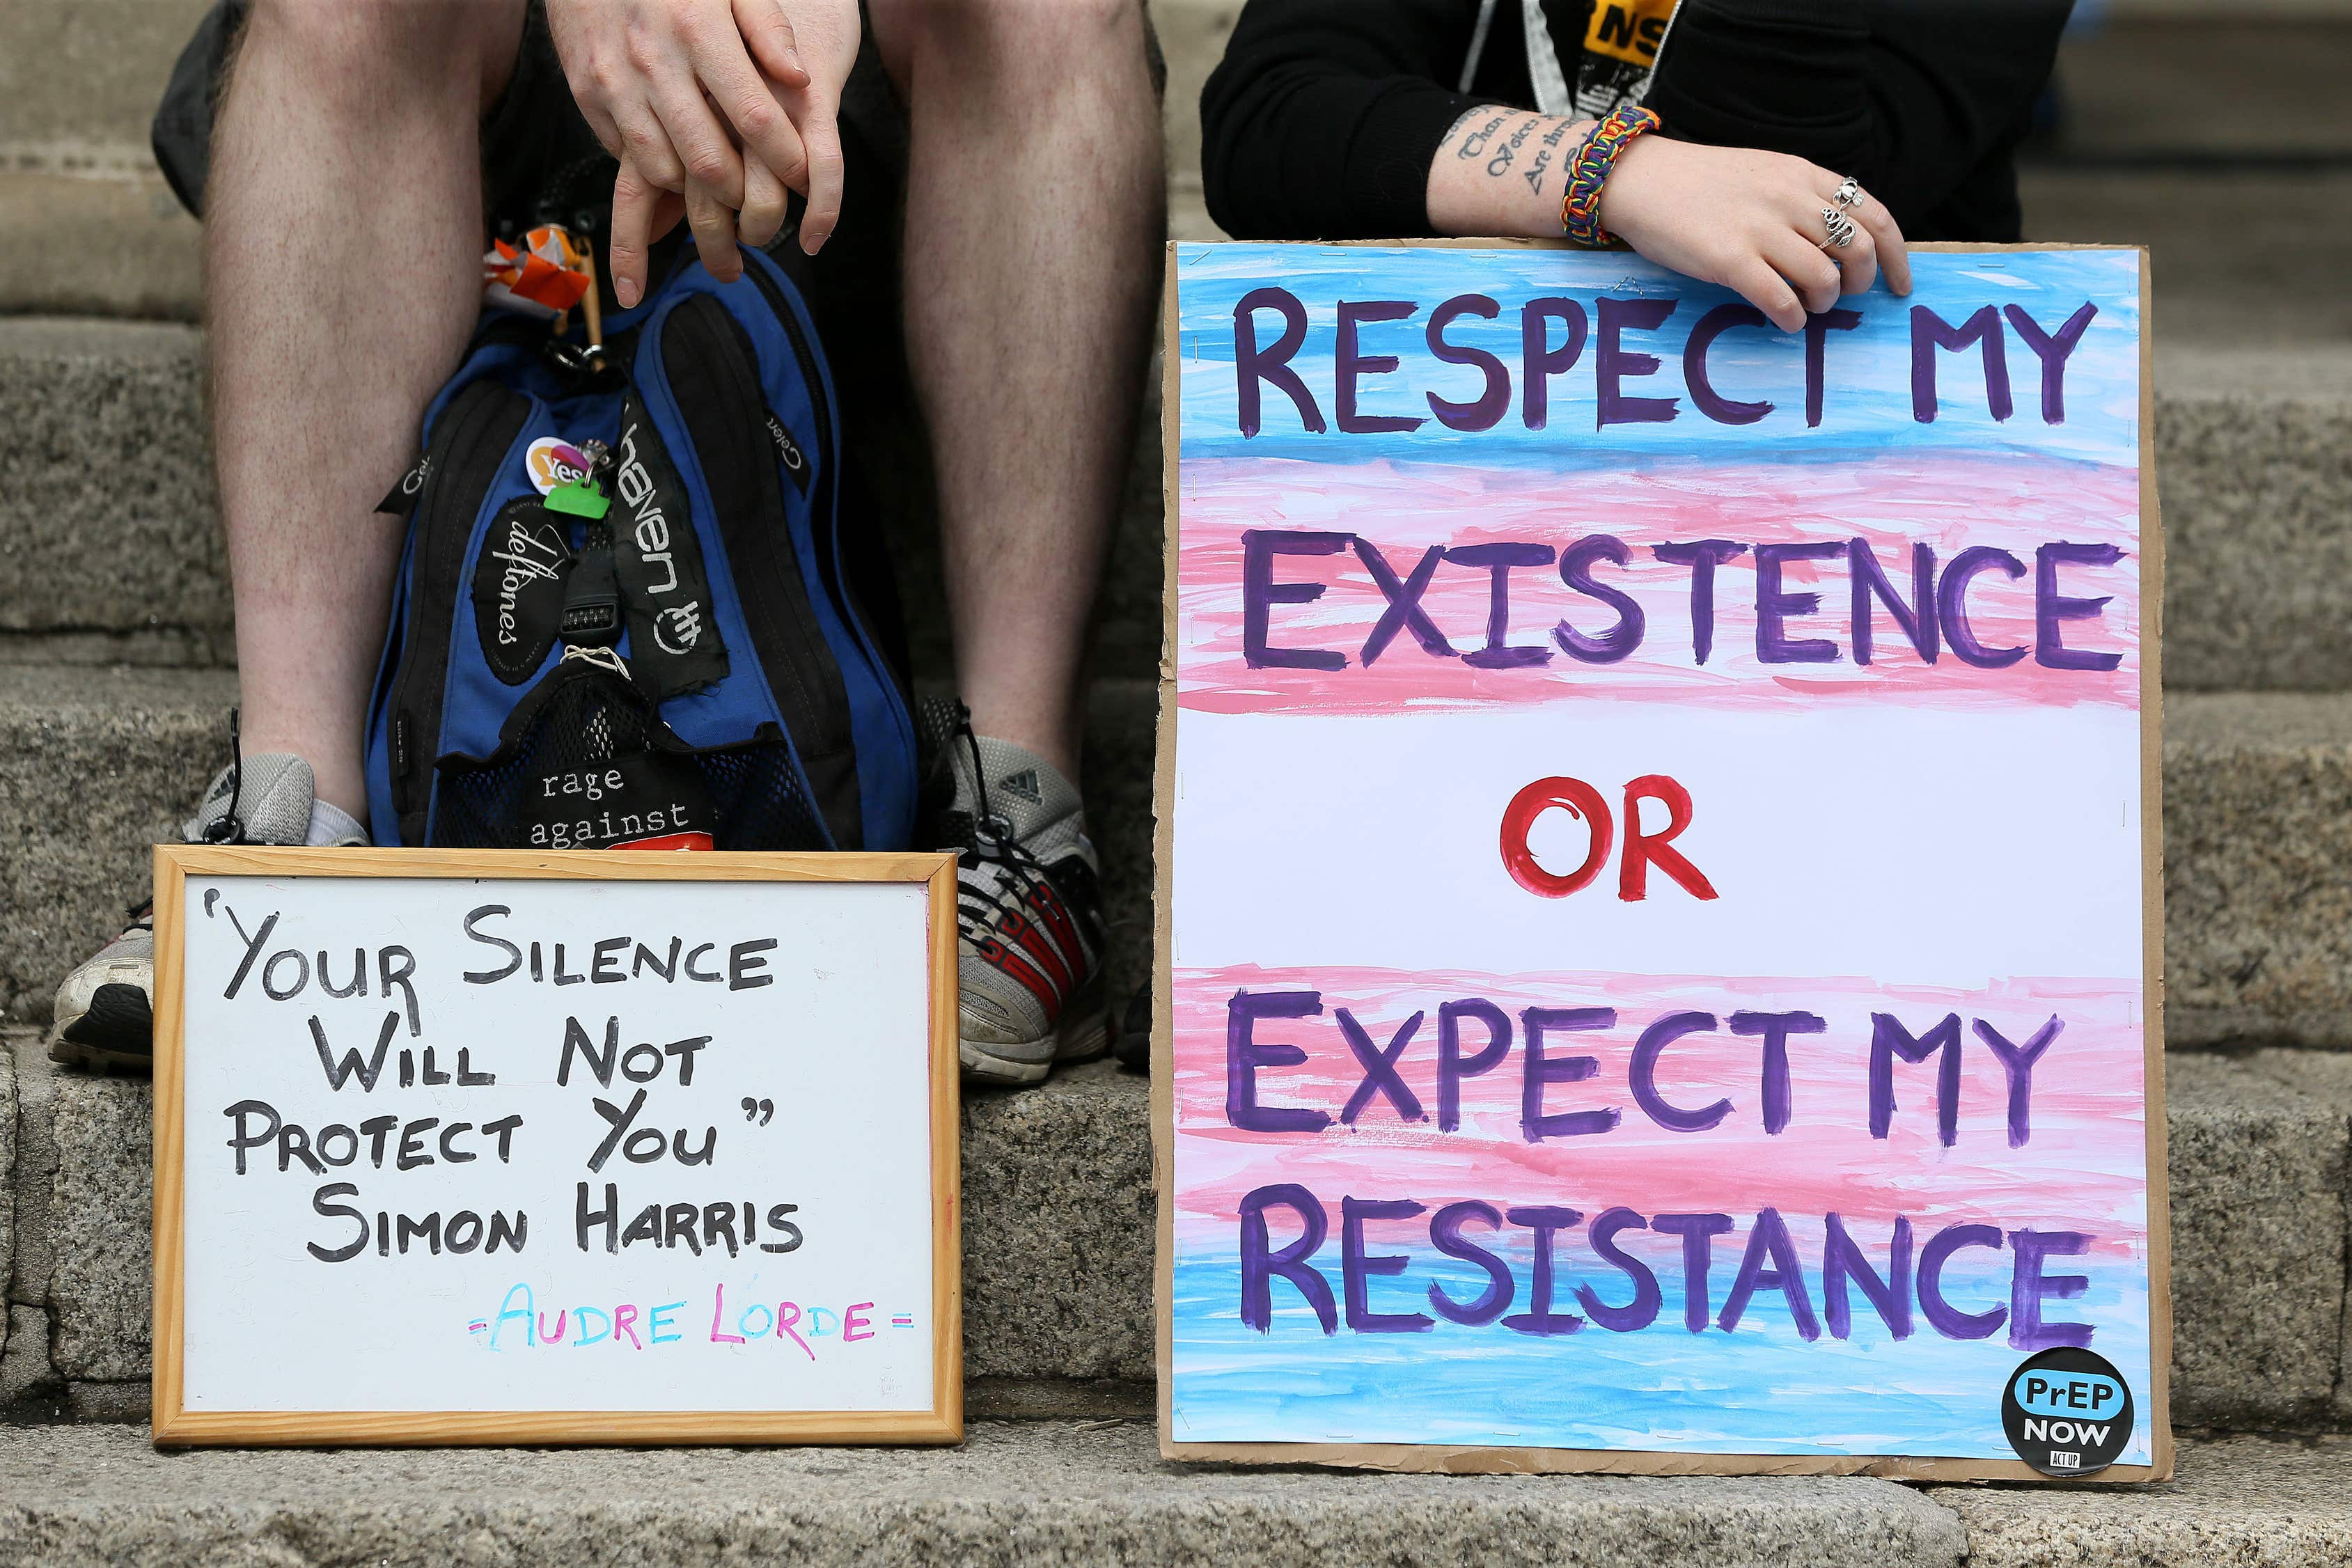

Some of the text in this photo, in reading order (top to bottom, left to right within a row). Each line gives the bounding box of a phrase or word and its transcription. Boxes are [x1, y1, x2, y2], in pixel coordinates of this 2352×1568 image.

[1233, 286, 2098, 439] RESPECT MY
[540, 453, 583, 485] Yes
[492, 521, 570, 645] deftones
[1241, 528, 2126, 671] EXISTENCE
[543, 769, 624, 800] rage
[531, 803, 689, 850] against
[1500, 774, 1719, 902] OR
[464, 905, 777, 991] SILENCE
[308, 1011, 712, 1092] WILL NOT
[1226, 988, 2062, 1148] EXPECT MY
[224, 1100, 523, 1175] PROTECT
[306, 1182, 803, 1262] SIMON HARRIS
[1237, 1183, 2097, 1352] RESISTANCE
[2023, 1418, 2111, 1447] NOW
[2026, 1377, 2113, 1410] PrEP
[2053, 1452, 2078, 1466] ACT UP
